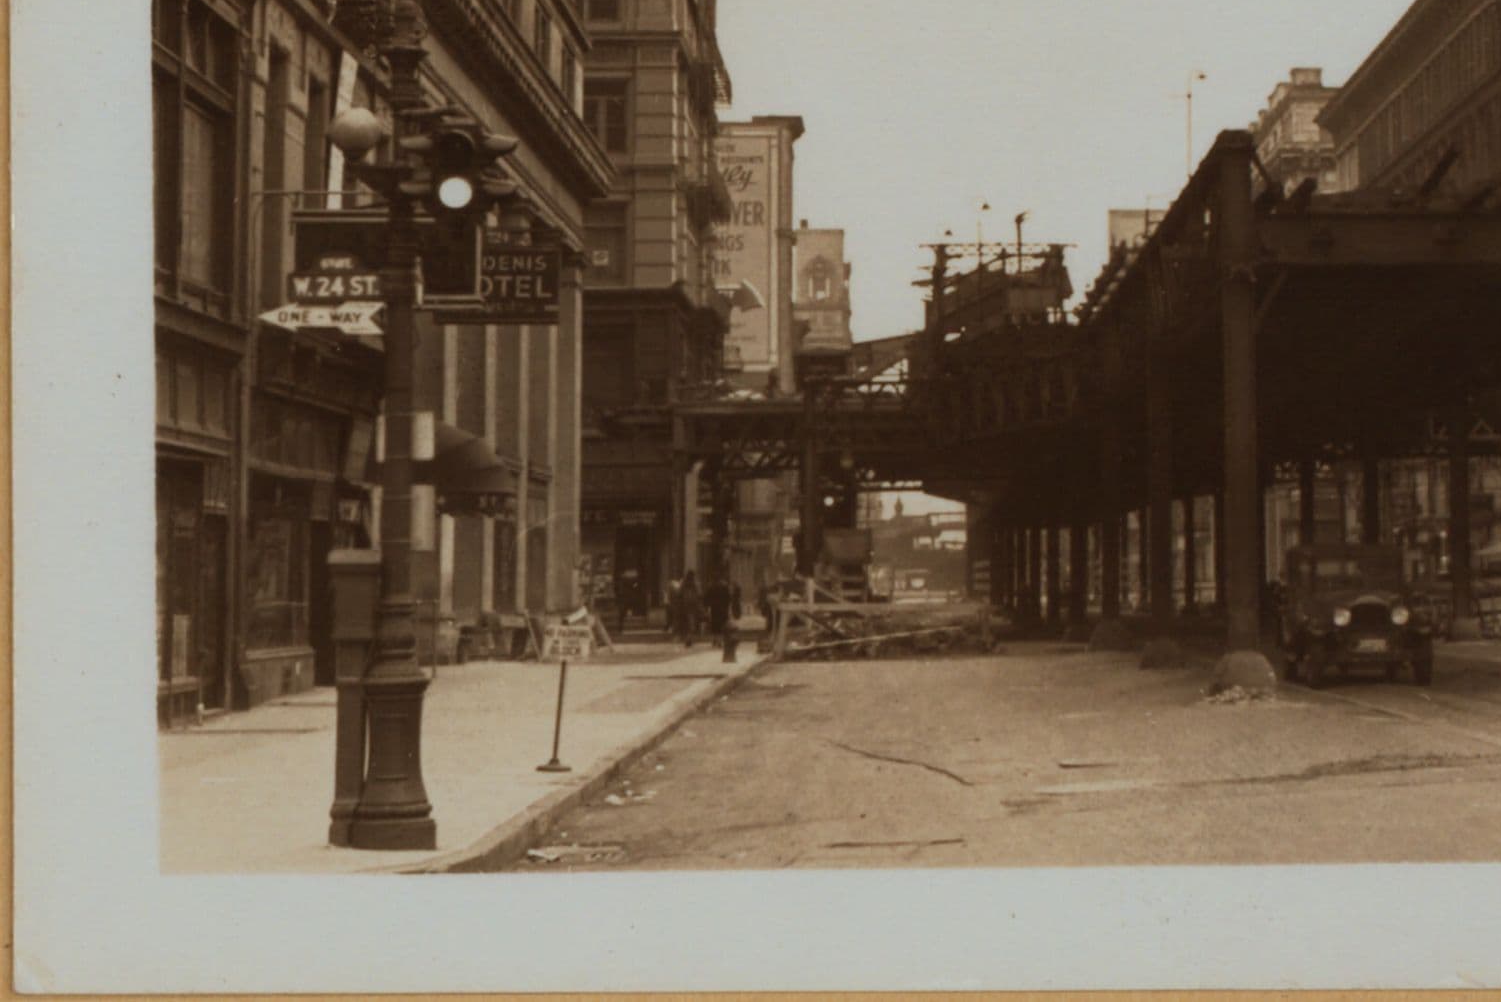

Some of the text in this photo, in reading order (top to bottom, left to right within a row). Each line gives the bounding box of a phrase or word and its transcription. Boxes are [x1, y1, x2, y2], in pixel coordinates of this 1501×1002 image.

[482, 255, 548, 271] DENIS
[293, 275, 381, 298] W. 24 ST.
[480, 275, 553, 298] OTEL
[278, 311, 309, 324] ONE
[329, 312, 361, 324] WAY
